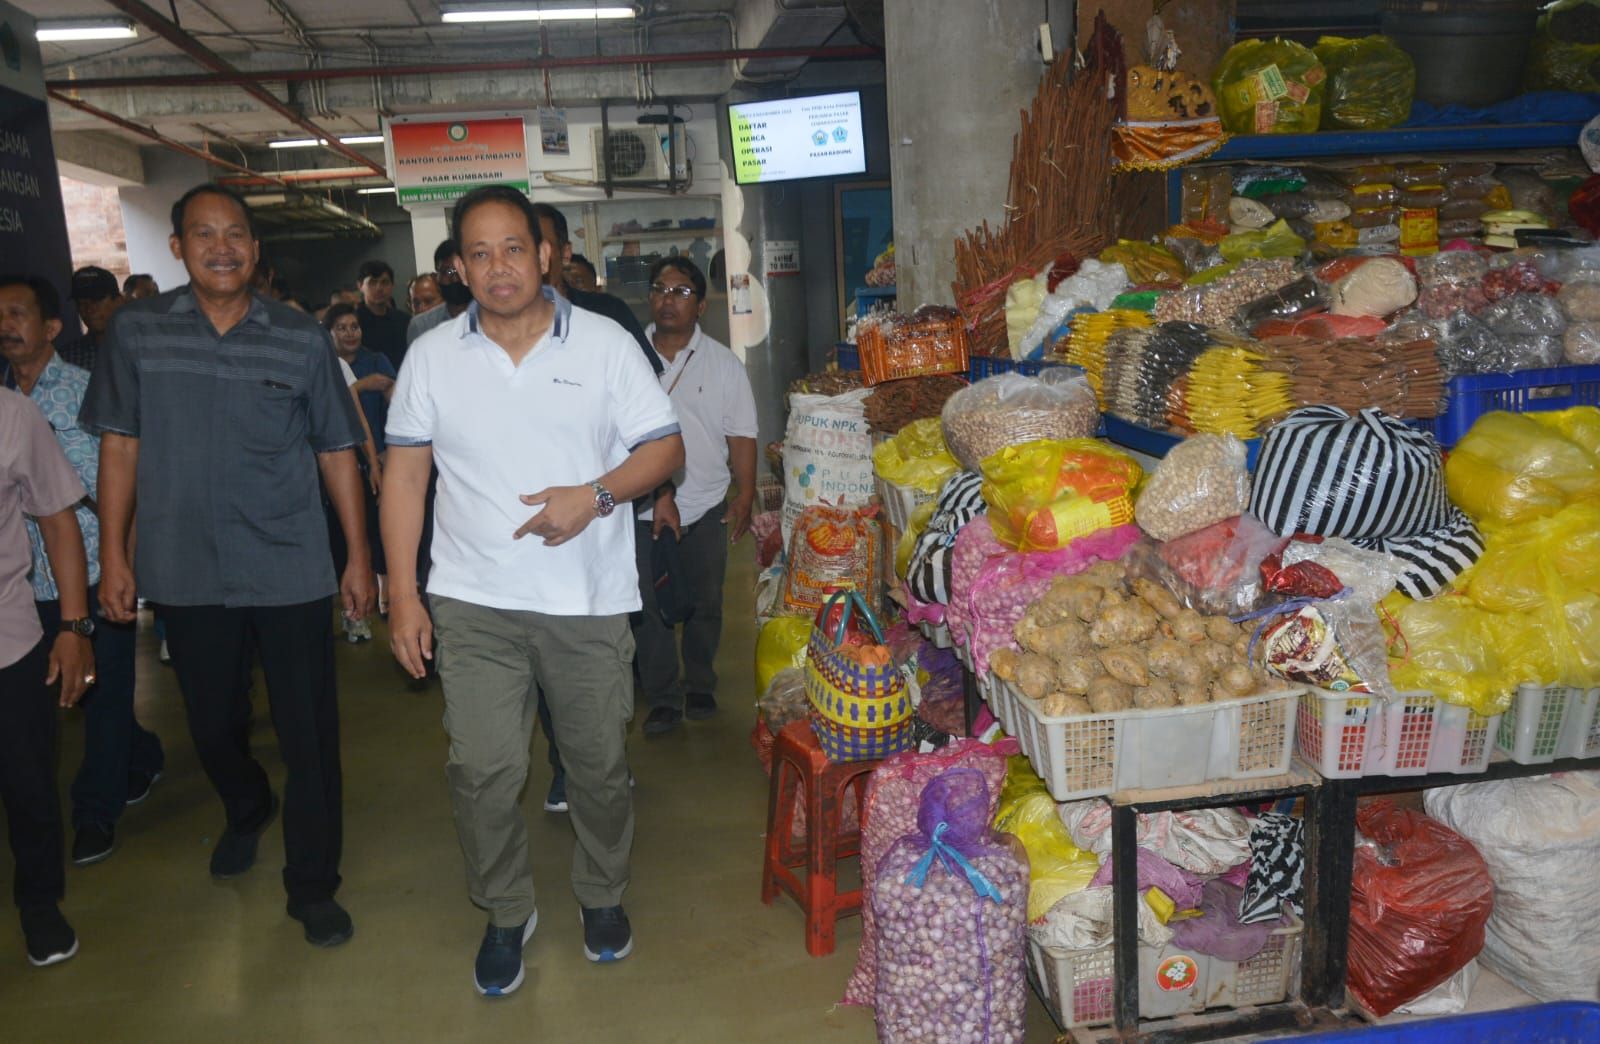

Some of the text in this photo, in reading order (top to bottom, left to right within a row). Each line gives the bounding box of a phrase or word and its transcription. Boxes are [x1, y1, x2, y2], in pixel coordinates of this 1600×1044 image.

[738, 122, 767, 131] DAFTAR
[741, 146, 773, 155] OPERASI
[399, 151, 522, 166] KANTOR CABANG PEMBANTU
[742, 159, 767, 167] PASAR
[422, 171, 503, 183] PASAR KUMBASARI
[0, 168, 41, 199] ANGAN
[402, 193, 419, 201] BANK
[433, 191, 447, 200] BALI
[448, 190, 466, 199] CABA
[831, 420, 858, 433] NPK
[821, 480, 876, 494] INDONE
